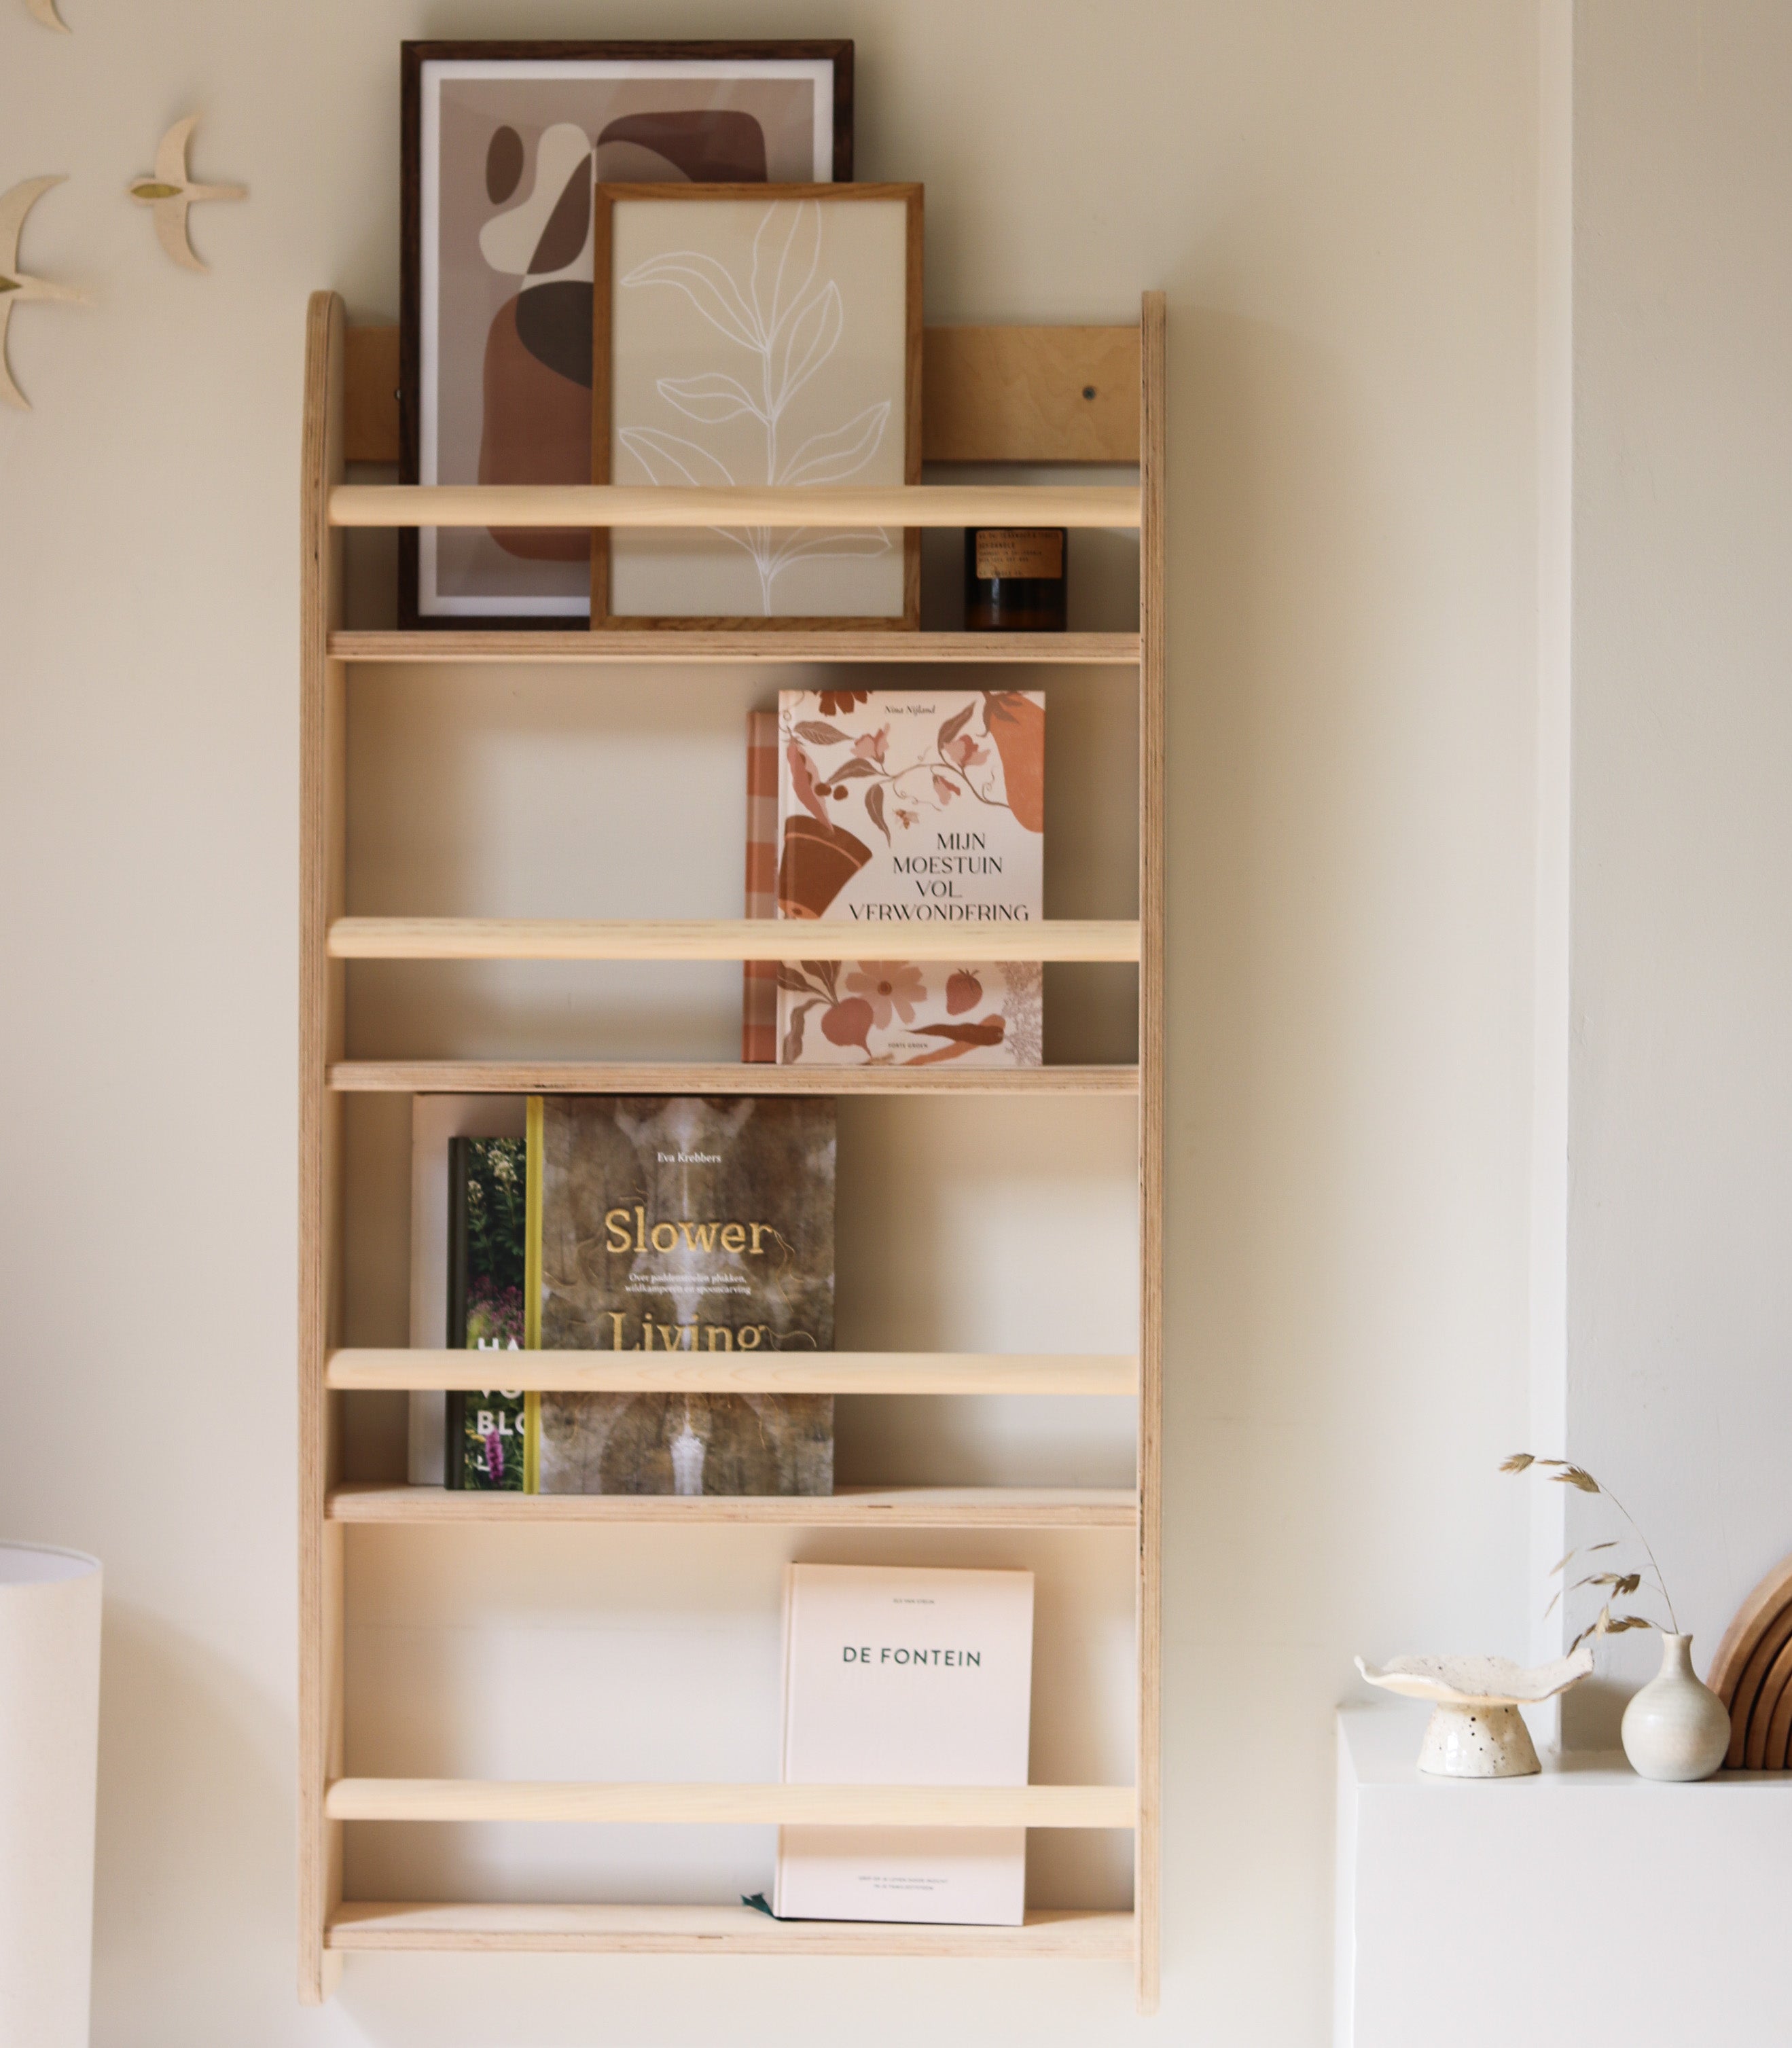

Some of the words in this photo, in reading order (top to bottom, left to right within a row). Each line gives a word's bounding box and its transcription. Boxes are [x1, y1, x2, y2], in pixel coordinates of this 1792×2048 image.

[937, 833, 986, 850] MIJN
[893, 856, 1003, 874] MOESTUIN
[915, 880, 963, 898] VOL
[849, 903, 1029, 921] VERWONDERING
[657, 1152, 675, 1163] Eva
[677, 1152, 722, 1163] Krebbers
[605, 1206, 773, 1255] Slower
[629, 1273, 649, 1282] Over
[609, 1312, 766, 1351] Living
[843, 1647, 871, 1663] DE
[881, 1648, 981, 1666] FONTEIN
